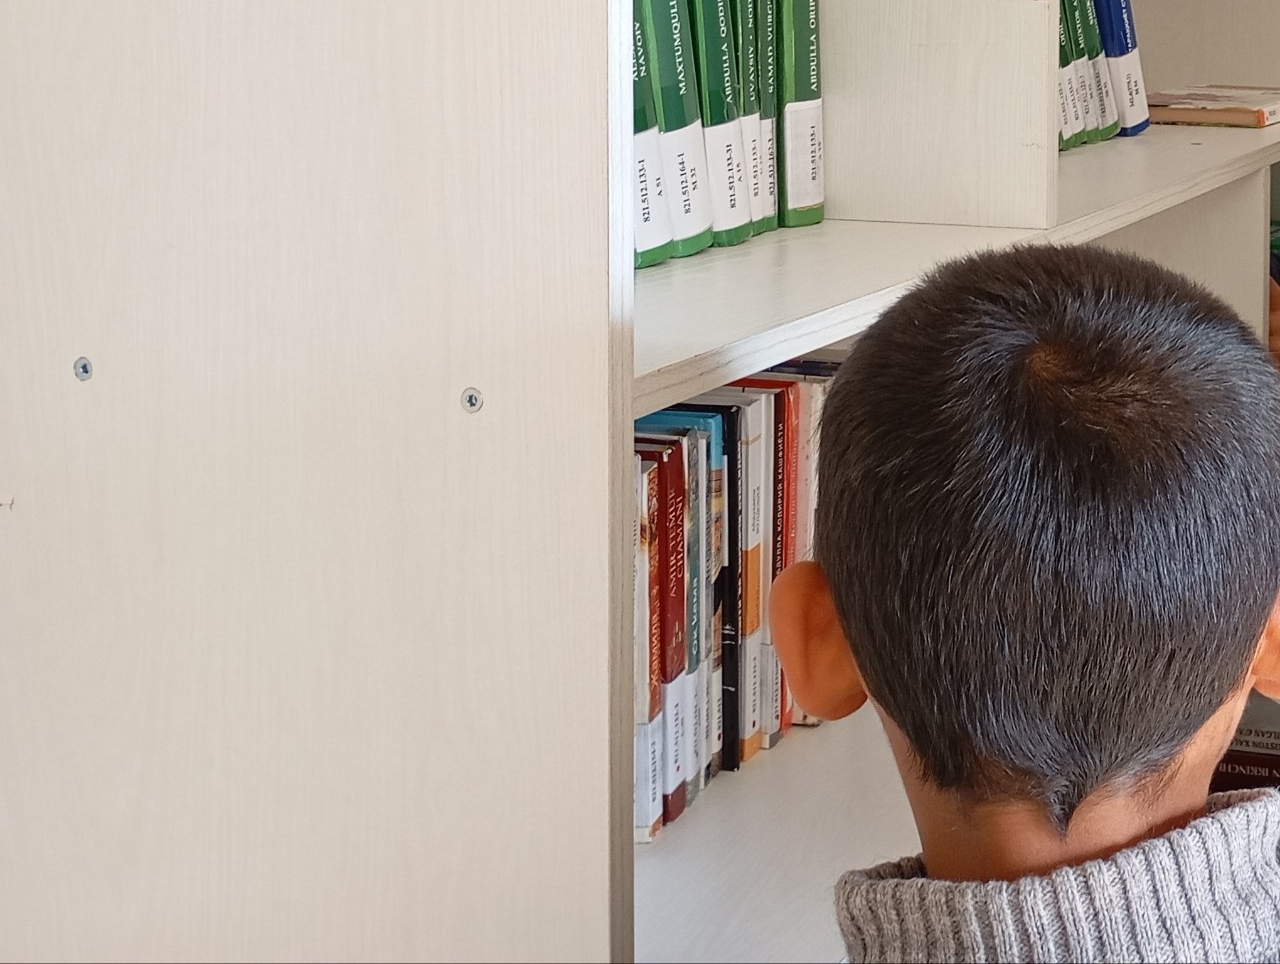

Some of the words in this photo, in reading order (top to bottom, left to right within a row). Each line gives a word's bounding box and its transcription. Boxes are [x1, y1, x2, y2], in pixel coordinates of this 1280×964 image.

[633, 20, 646, 76] NAVOIY
[669, 0, 686, 95] MAXTUMQULI
[1074, 10, 1085, 48] MUXTOR
[720, 42, 733, 103] ABDULLA
[809, 33, 817, 91] ABDULLA
[638, 158, 650, 222] 821.512.133-1
[677, 151, 690, 214] 821.512.164-1
[726, 143, 736, 208] 821.512.133-31
